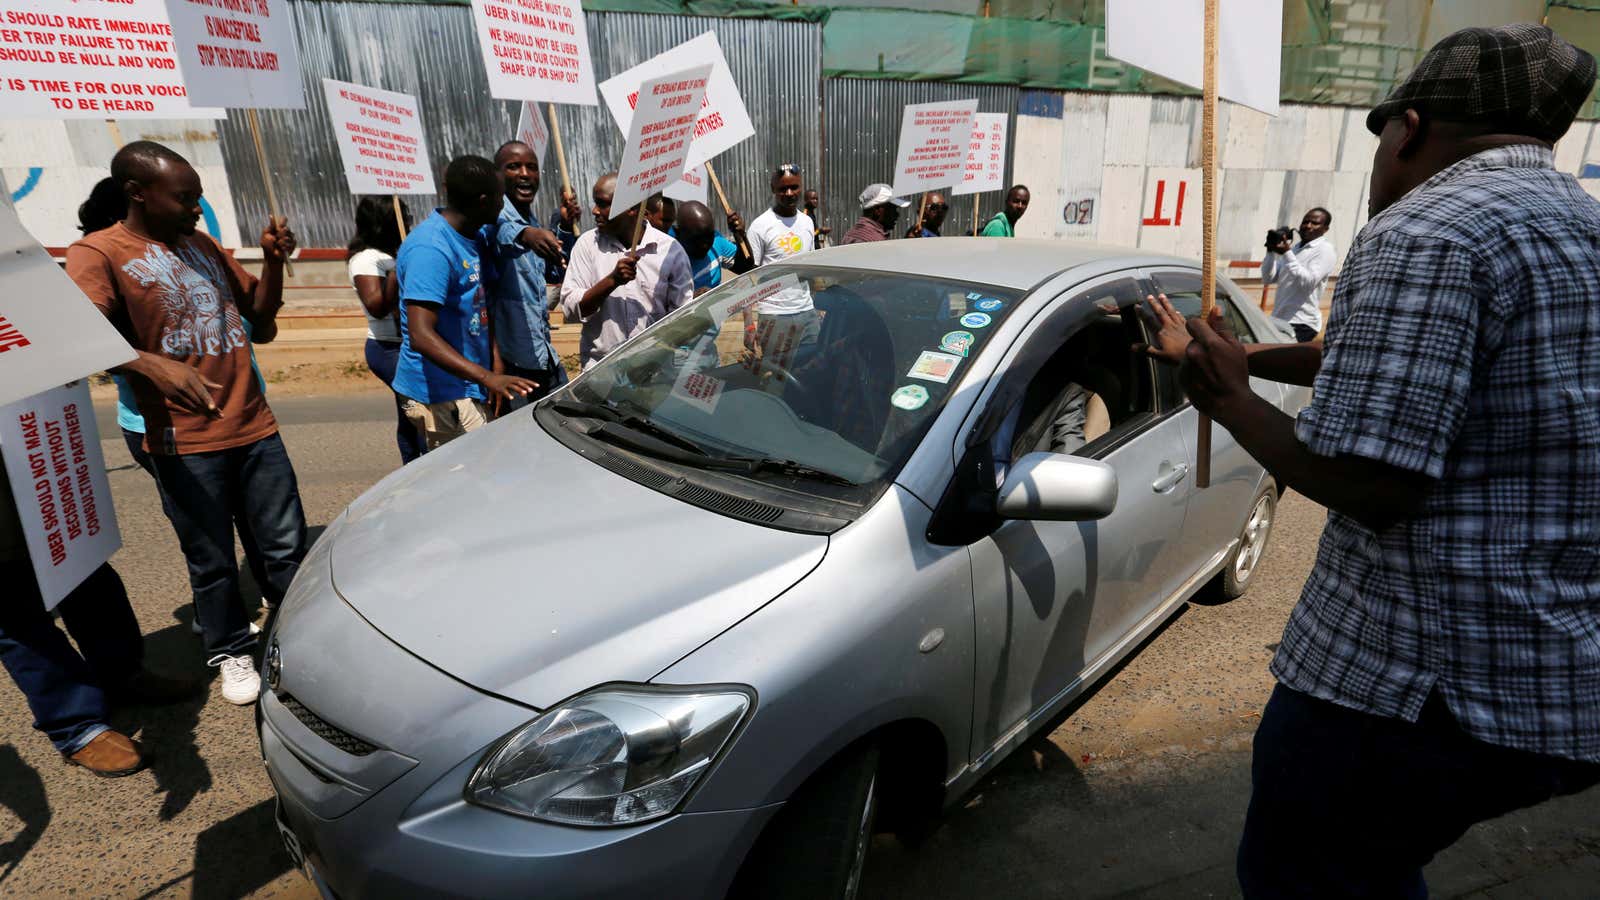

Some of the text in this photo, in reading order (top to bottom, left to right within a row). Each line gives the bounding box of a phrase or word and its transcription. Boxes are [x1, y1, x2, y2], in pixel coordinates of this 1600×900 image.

[6, 10, 64, 27] SHOULD
[67, 16, 102, 31] RATE
[484, 4, 575, 35] UBER SI MAMA YA MTU
[545, 2, 561, 15] MUST
[563, 6, 572, 18] GO
[24, 31, 56, 45] TRIP
[59, 34, 115, 49] FAILURE
[116, 38, 134, 50] TO
[136, 39, 168, 52] THAT
[204, 15, 262, 43] IS UNACCEPTABLE
[488, 27, 578, 55] WE SHOULD NOT BE UBER
[0, 47, 175, 69] SHOULD BE NULL AND VOID
[197, 43, 279, 72] STOP THIS DIGITAL SLAVERY
[493, 44, 579, 70] SLAVES IN OUR COUNTRY
[500, 61, 579, 83] SHAPE UP OR SHIP OUT
[7, 79, 26, 91] IS
[28, 79, 71, 93] TIME
[73, 81, 107, 94] FOR
[111, 83, 144, 96] OUR
[50, 97, 154, 112] TO BE HEARD
[44, 420, 82, 540] DECISIONS WITHOUT
[63, 403, 101, 537] CONSULTING PARTNERS
[19, 411, 67, 566] UBER SHOULD NOT MAKE
